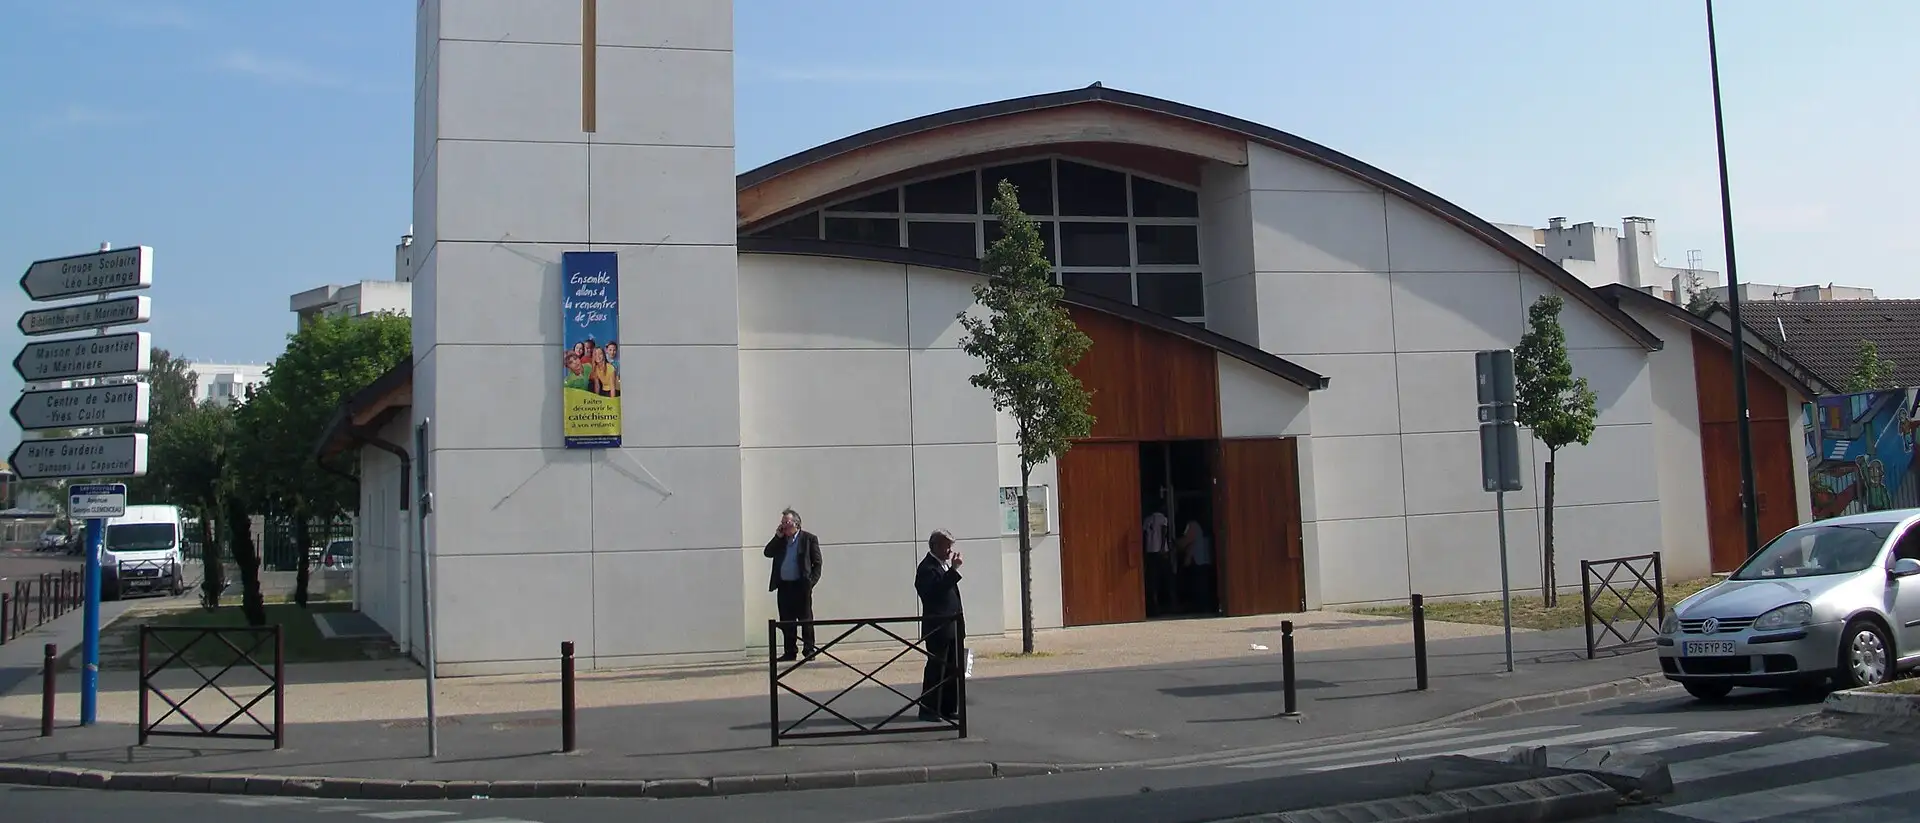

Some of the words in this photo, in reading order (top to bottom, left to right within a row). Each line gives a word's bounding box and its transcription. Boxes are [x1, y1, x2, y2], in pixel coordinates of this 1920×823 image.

[61, 263, 92, 275] Groupe
[99, 256, 137, 270] Scolaire
[88, 272, 134, 287] Lagrange
[575, 284, 598, 296] allons
[565, 296, 573, 309] la
[574, 296, 616, 309] rencontre
[574, 311, 585, 321] de
[36, 347, 71, 359] Maison
[75, 344, 86, 355] de
[91, 341, 134, 354] Quartier
[47, 395, 79, 408] Centre
[85, 393, 97, 405] de
[104, 390, 133, 404] Santé
[78, 408, 106, 421] Culot
[568, 412, 618, 420] catéchisme
[28, 446, 55, 458] Halte
[61, 444, 104, 457] Garderie
[1689, 643, 1703, 654] 576
[1704, 643, 1720, 653] FYP
[1722, 642, 1733, 653] 92
